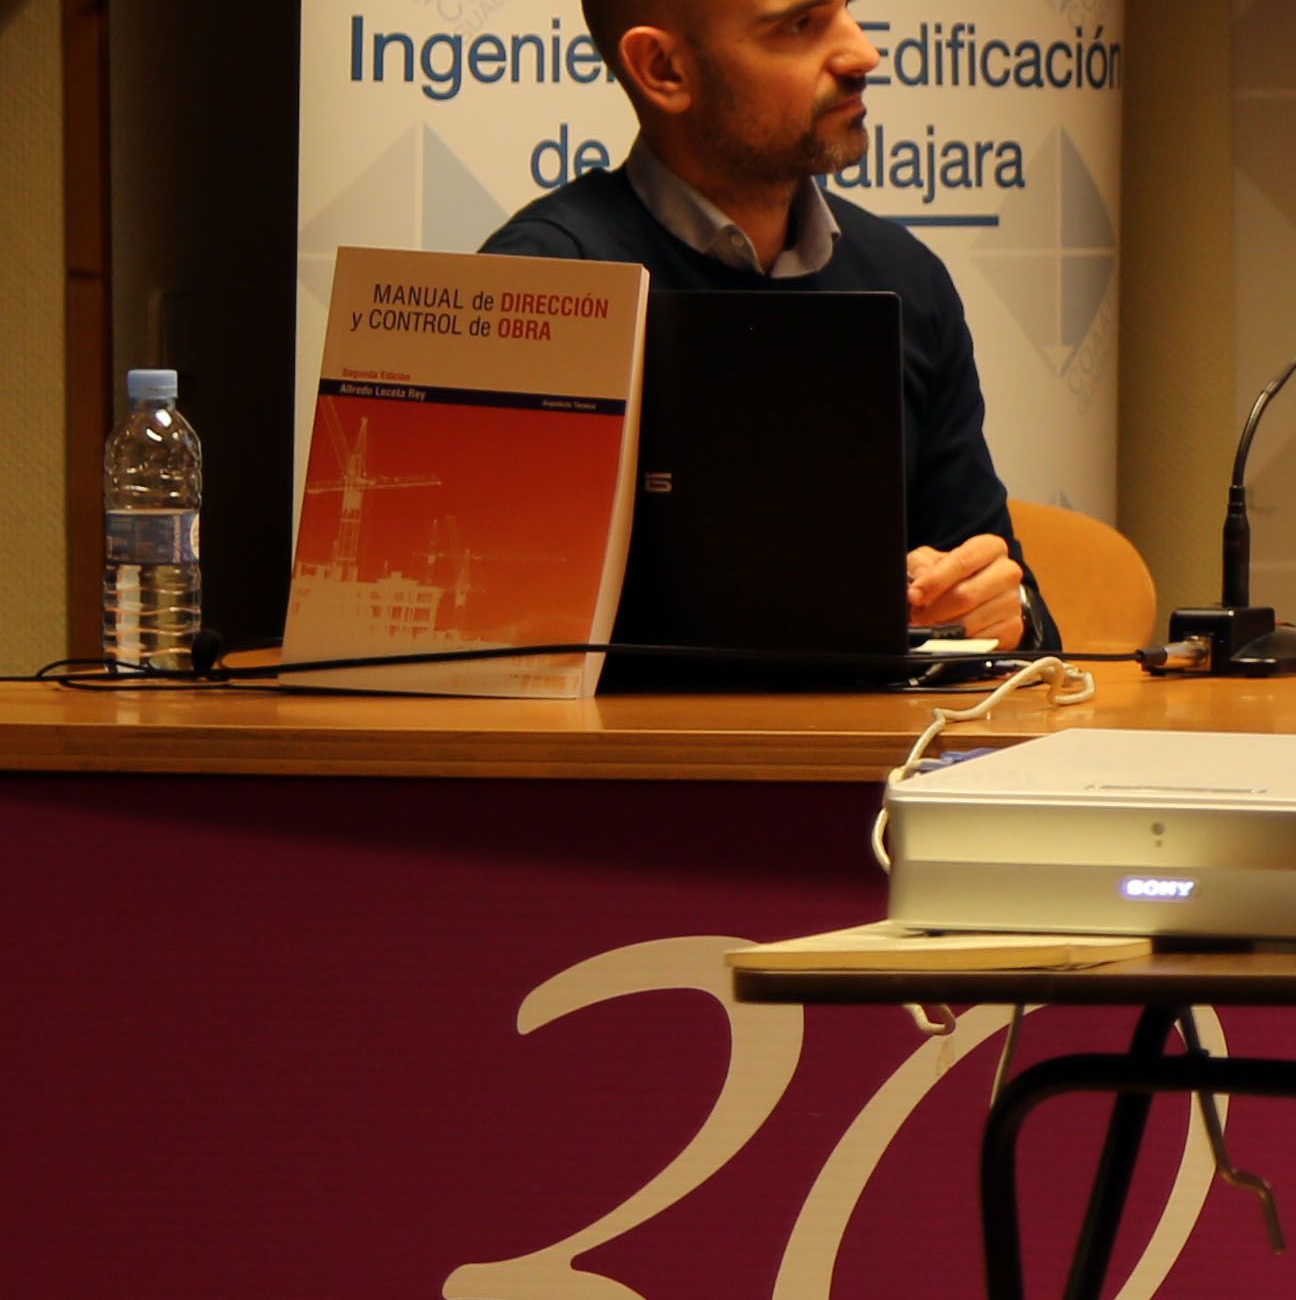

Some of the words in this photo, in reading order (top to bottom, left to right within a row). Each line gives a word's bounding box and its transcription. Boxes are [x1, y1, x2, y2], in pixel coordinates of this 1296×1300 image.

[351, 16, 616, 101] Ingenie
[530, 123, 610, 189] de
[816, 124, 1026, 203] alajara
[373, 283, 464, 310] MANUAL
[472, 290, 495, 312] de
[501, 292, 609, 319] DIRECCIÓN
[350, 312, 363, 332] y
[368, 309, 462, 335] CONTROL
[469, 316, 491, 338] de
[498, 319, 551, 341] OBRA
[1125, 878, 1195, 897] SONY
